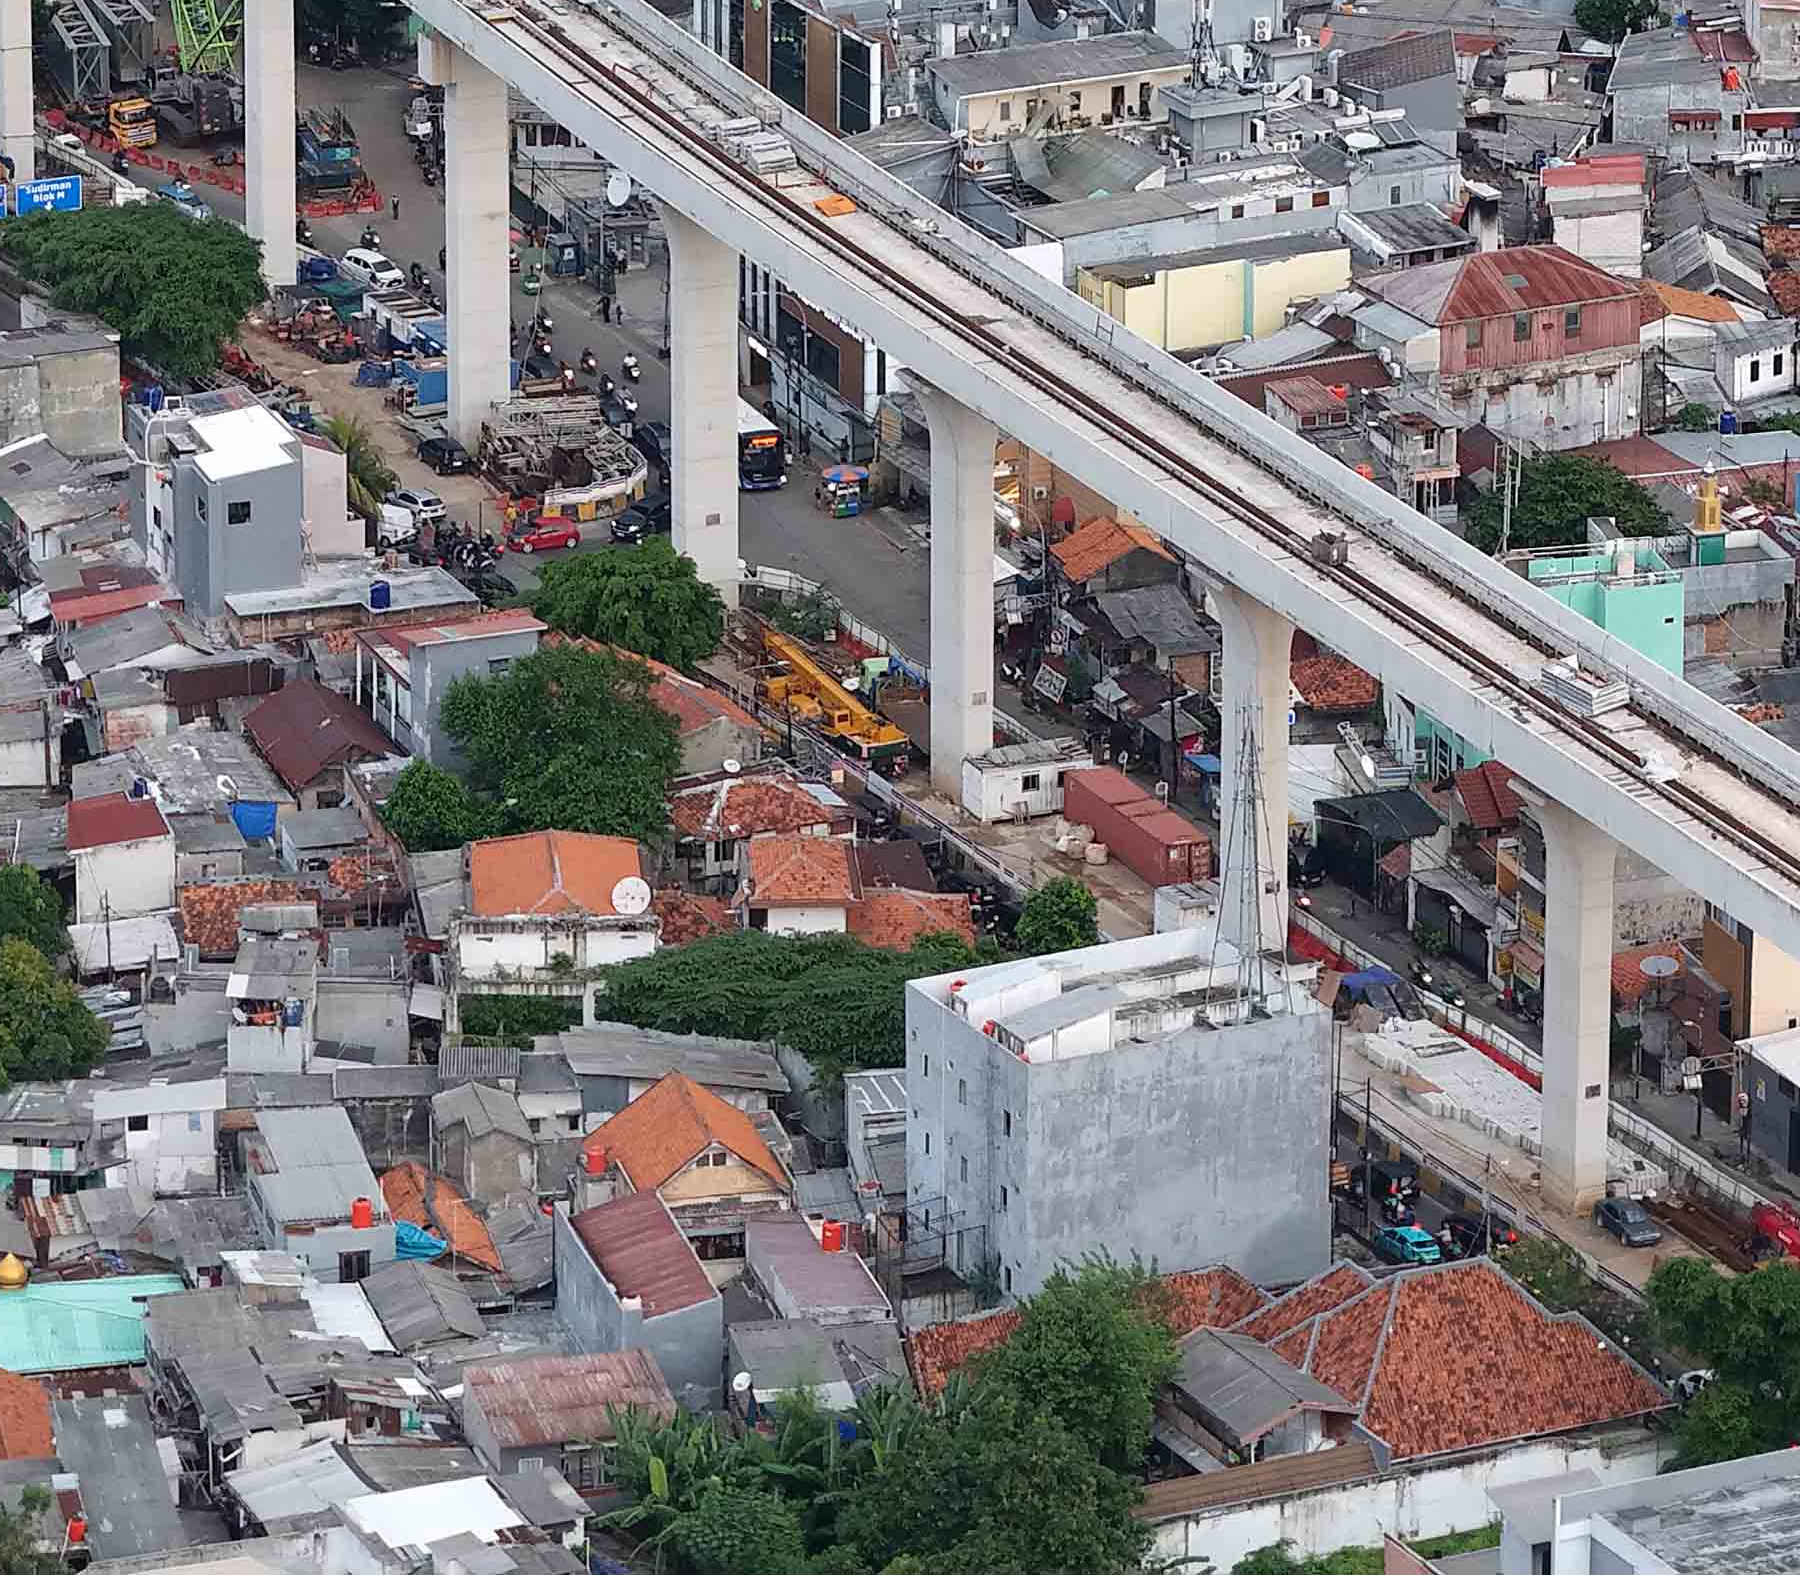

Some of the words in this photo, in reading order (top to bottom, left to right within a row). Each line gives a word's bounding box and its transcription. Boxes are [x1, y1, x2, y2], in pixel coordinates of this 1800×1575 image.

[25, 182, 72, 194] Sudirman
[33, 191, 56, 203] Blok
[56, 190, 66, 200] M
